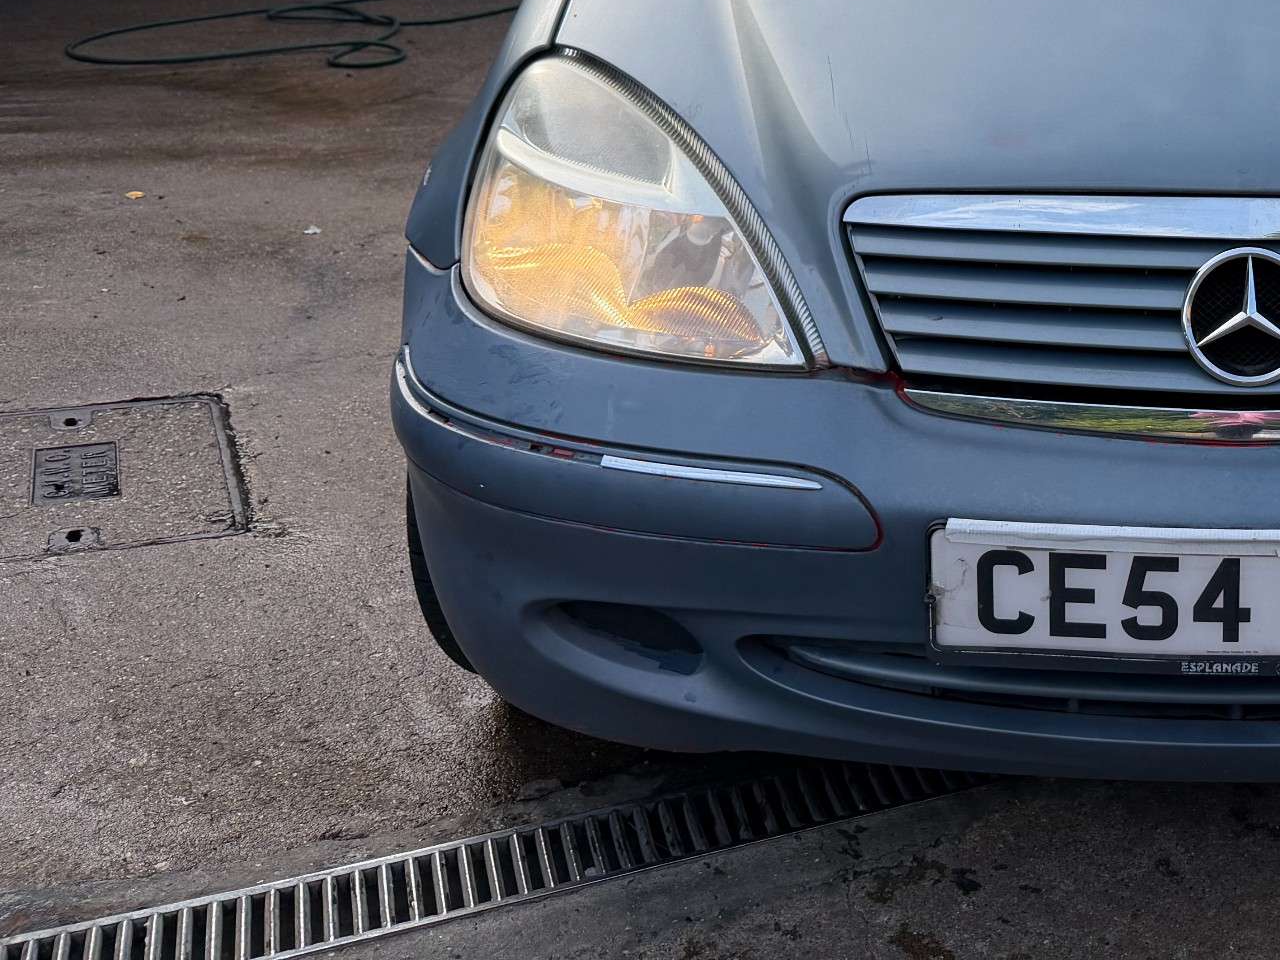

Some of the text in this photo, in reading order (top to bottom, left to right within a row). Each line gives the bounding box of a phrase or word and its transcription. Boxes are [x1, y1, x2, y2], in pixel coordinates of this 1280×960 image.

[81, 451, 109, 498] METER
[976, 549, 1251, 643] CE54
[1181, 662, 1259, 673] ESPLANADE
